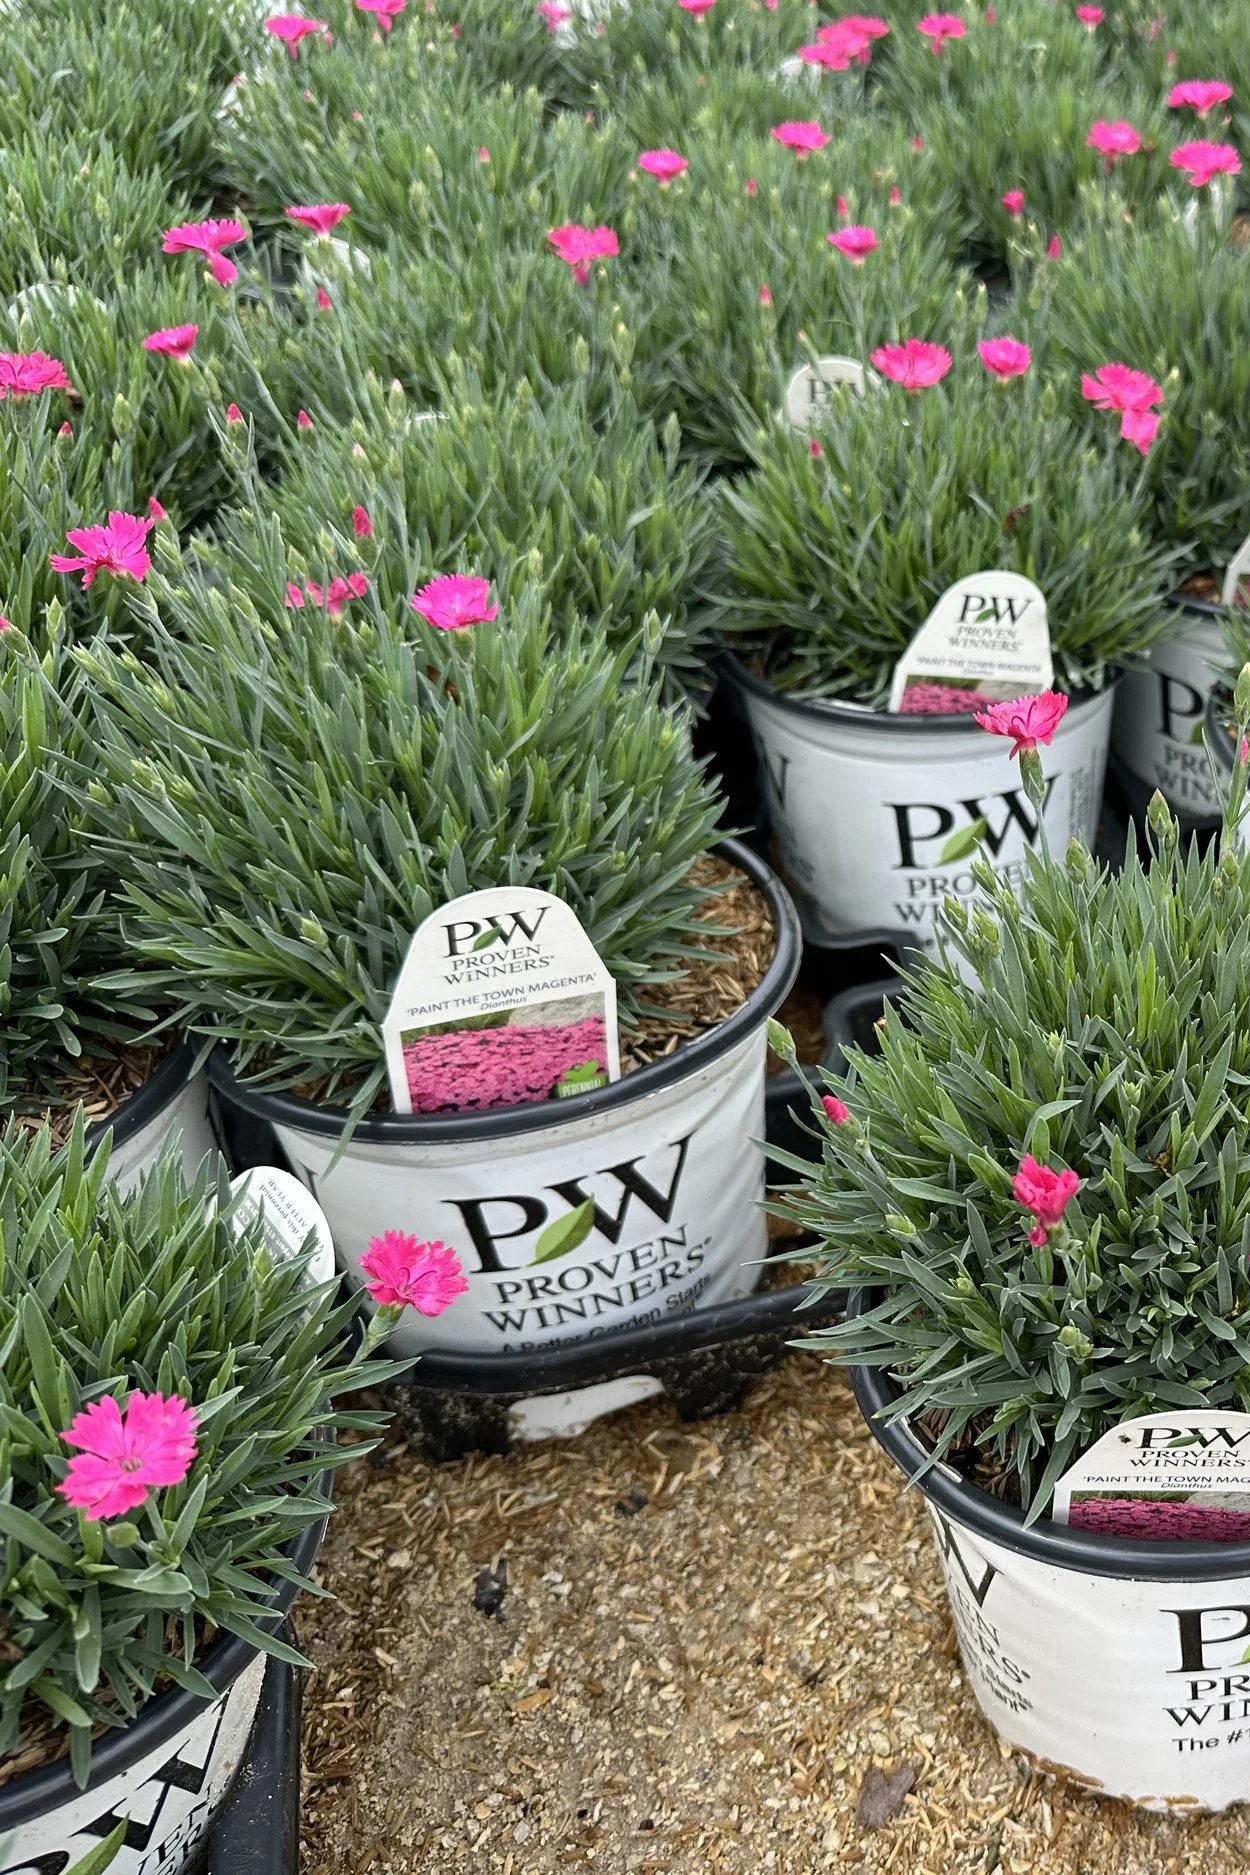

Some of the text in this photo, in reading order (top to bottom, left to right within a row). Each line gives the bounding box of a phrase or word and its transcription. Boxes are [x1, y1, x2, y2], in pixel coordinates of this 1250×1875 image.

[955, 593, 1035, 626] PW
[957, 626, 1019, 638] PROVEN
[1155, 672, 1204, 742] P
[1163, 745, 1222, 777] PRO
[882, 773, 1062, 870] PW
[440, 906, 552, 959] PW
[452, 944, 541, 971] PROVEN
[453, 995, 481, 1008] THE
[482, 986, 525, 1001] TOWN
[480, 996, 527, 1011] Dianthus
[440, 1129, 698, 1274] PW
[492, 1223, 687, 1304] PROVEN
[1141, 1450, 1239, 1458] PROVEN
[1133, 1475, 1162, 1483] THE
[1164, 1475, 1212, 1483] TOWN
[1171, 1736, 1219, 1751] The
[0, 1684, 234, 1875] W
